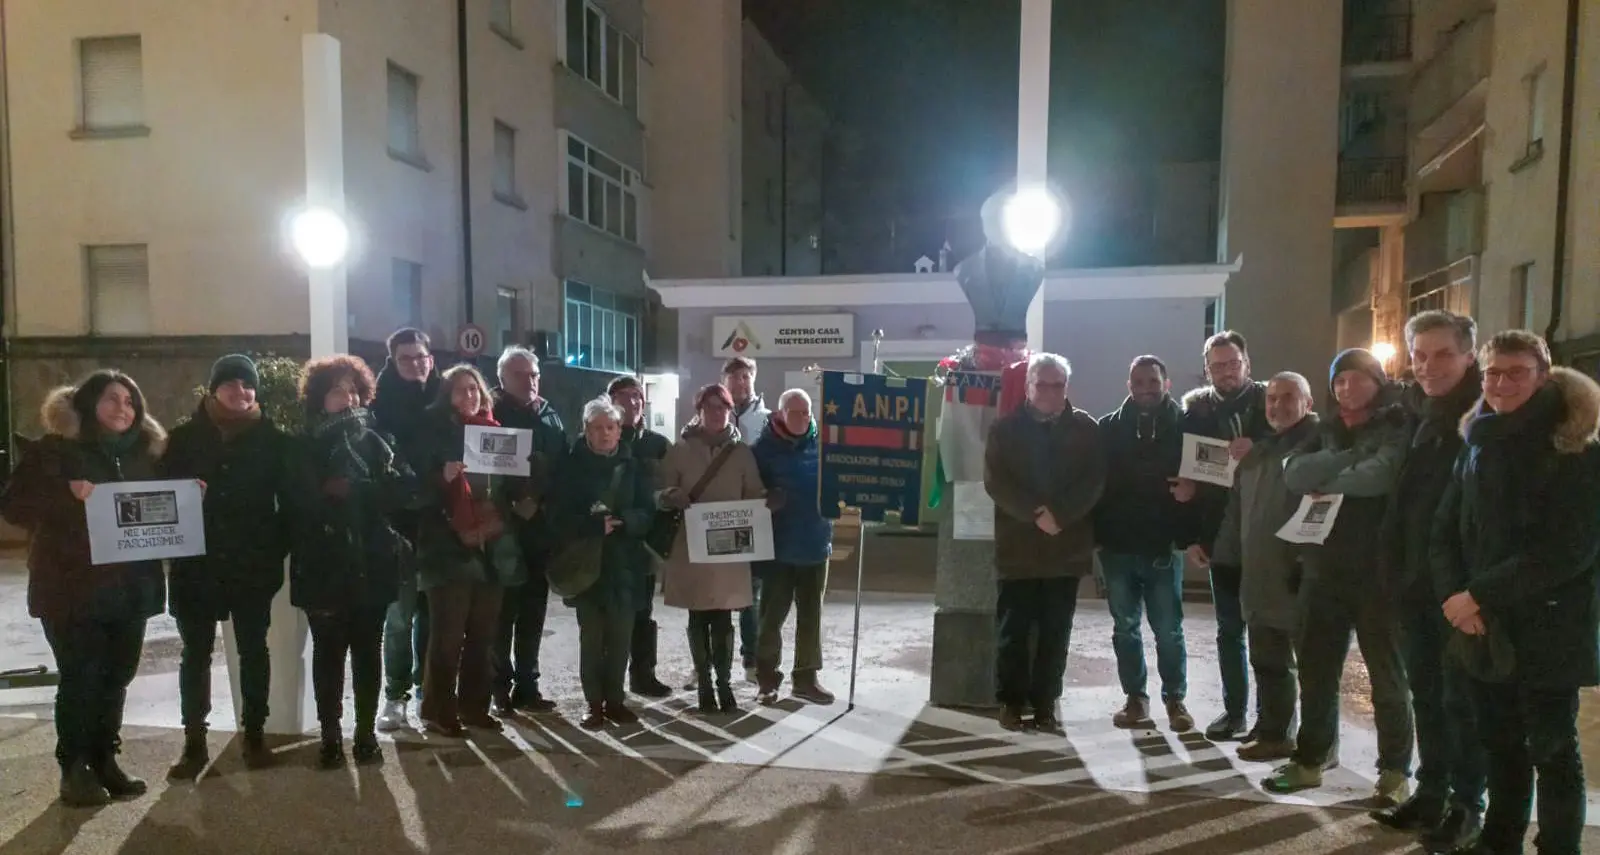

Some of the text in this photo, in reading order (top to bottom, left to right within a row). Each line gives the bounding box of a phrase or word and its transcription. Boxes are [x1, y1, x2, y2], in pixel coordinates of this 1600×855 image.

[779, 327, 840, 336] CENTRO CASA
[465, 333, 480, 349] 10
[774, 337, 845, 345] MIETERSCHUTZ
[123, 526, 177, 538] NIE WIEDER
[117, 535, 185, 550] FASCHISMUS
